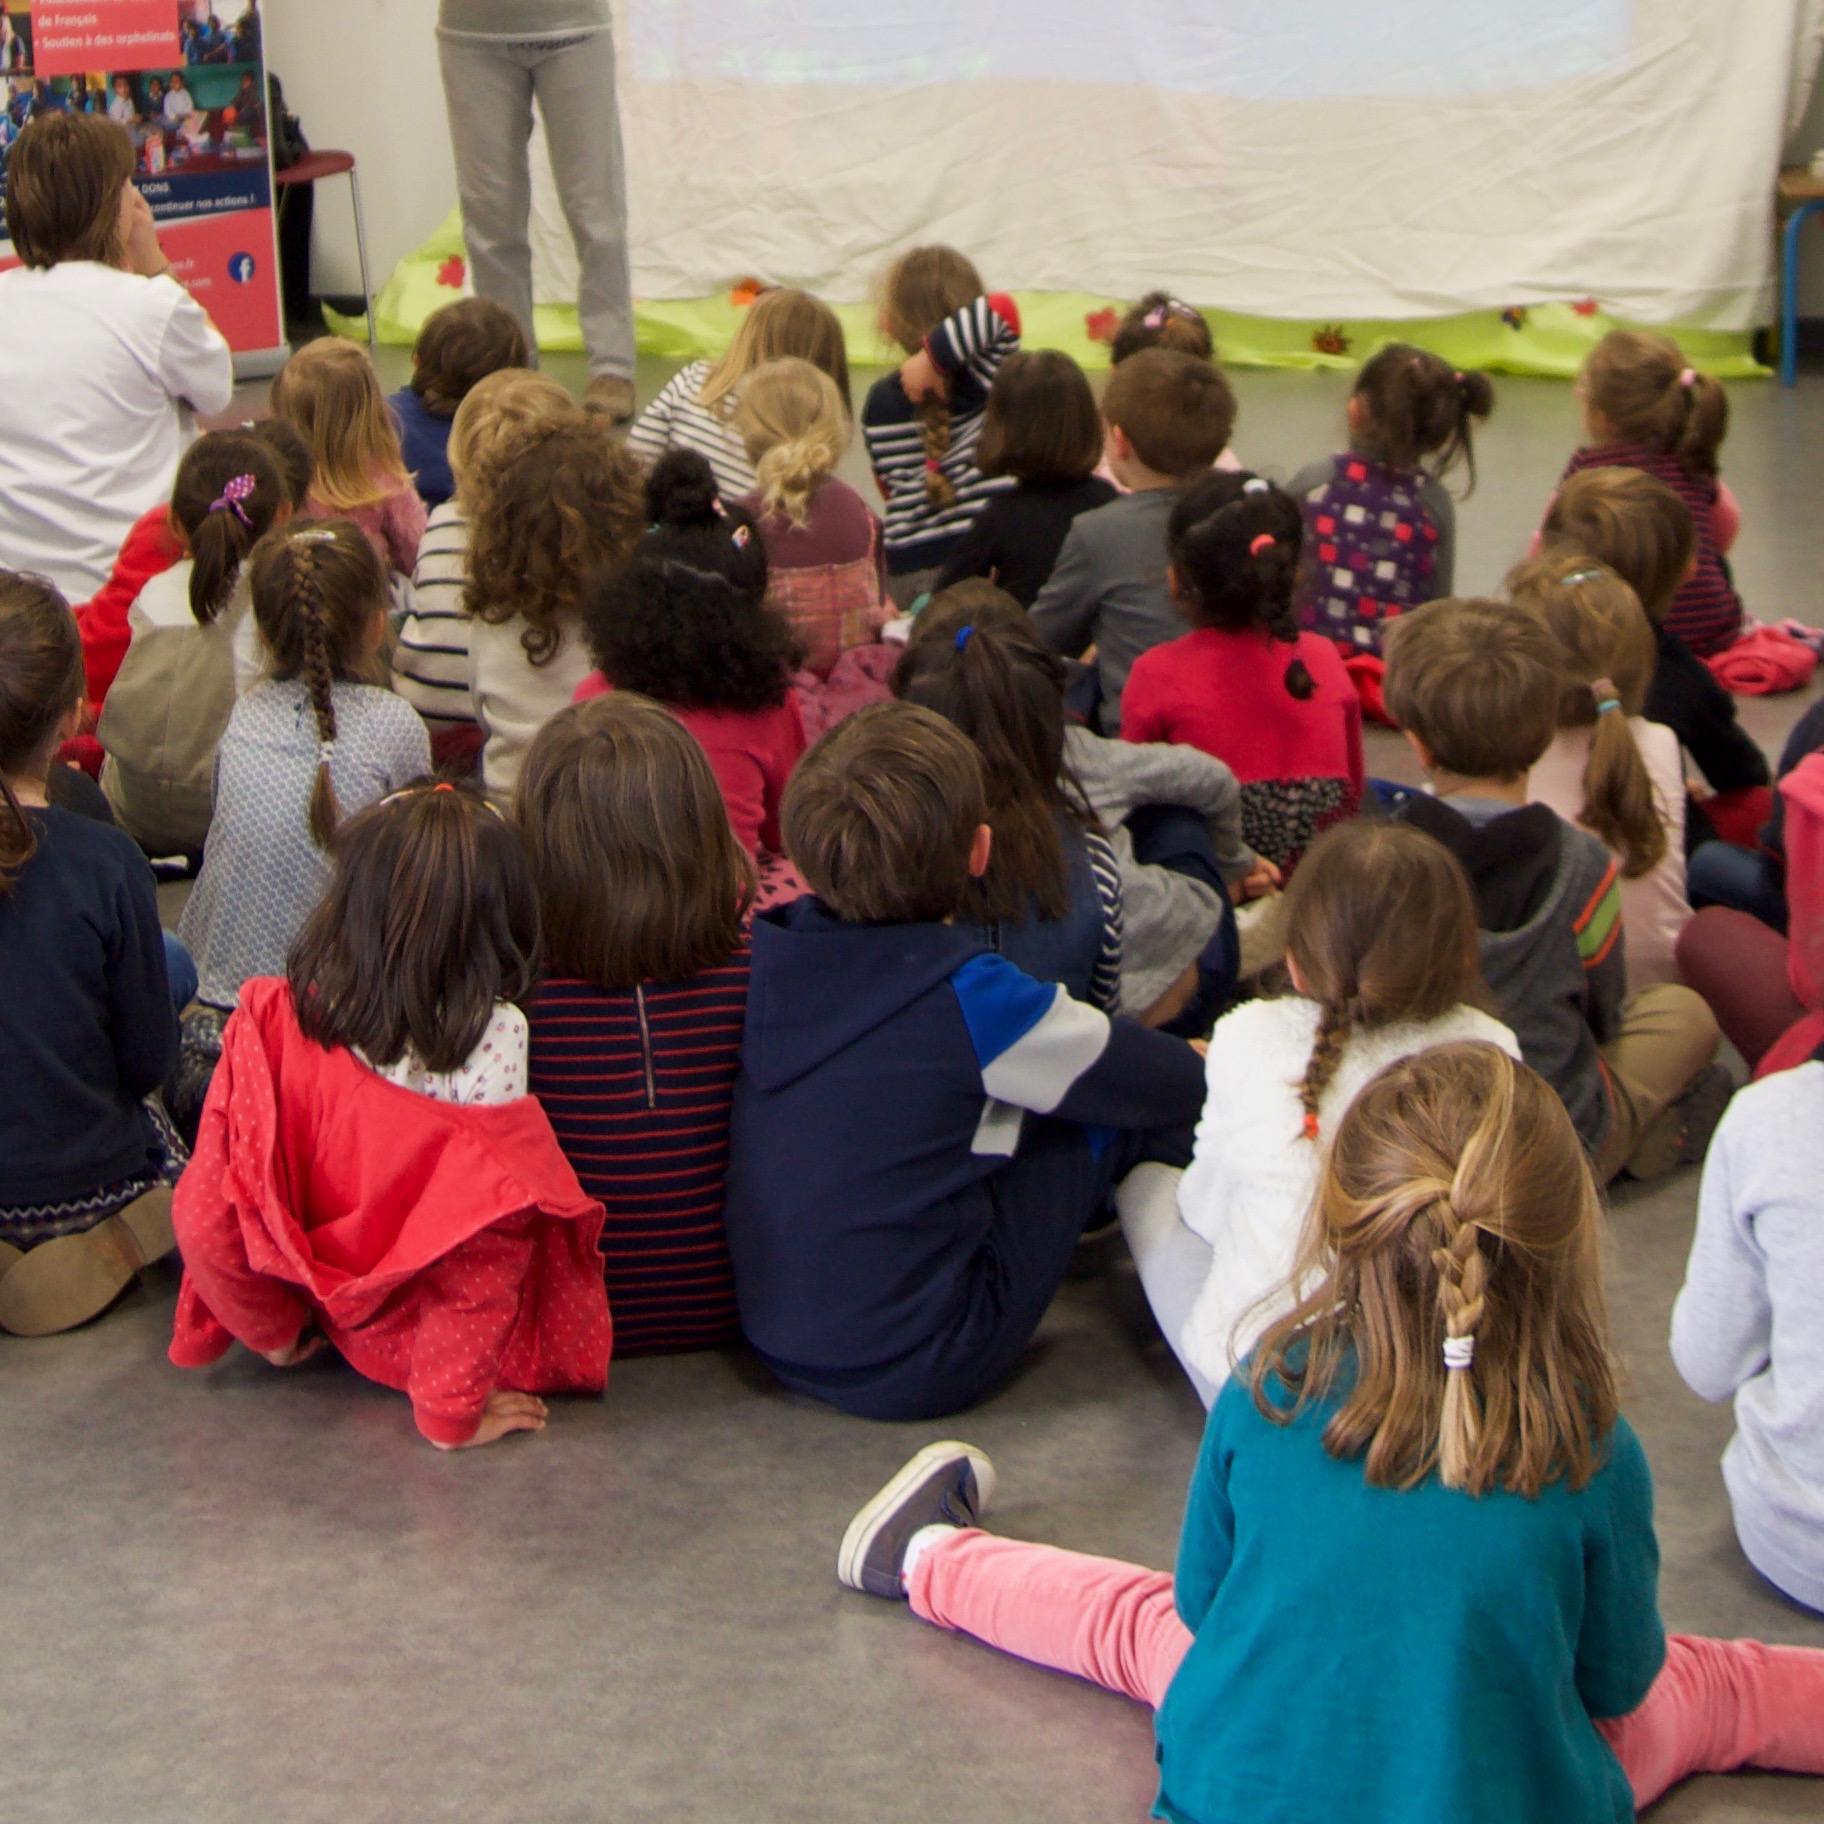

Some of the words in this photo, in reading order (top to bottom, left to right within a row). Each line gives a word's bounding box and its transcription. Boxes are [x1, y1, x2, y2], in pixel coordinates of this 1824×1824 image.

[37, 15, 52, 28] de
[42, 36, 83, 49] Soutien
[94, 33, 114, 46] des
[141, 182, 170, 194] DONS
